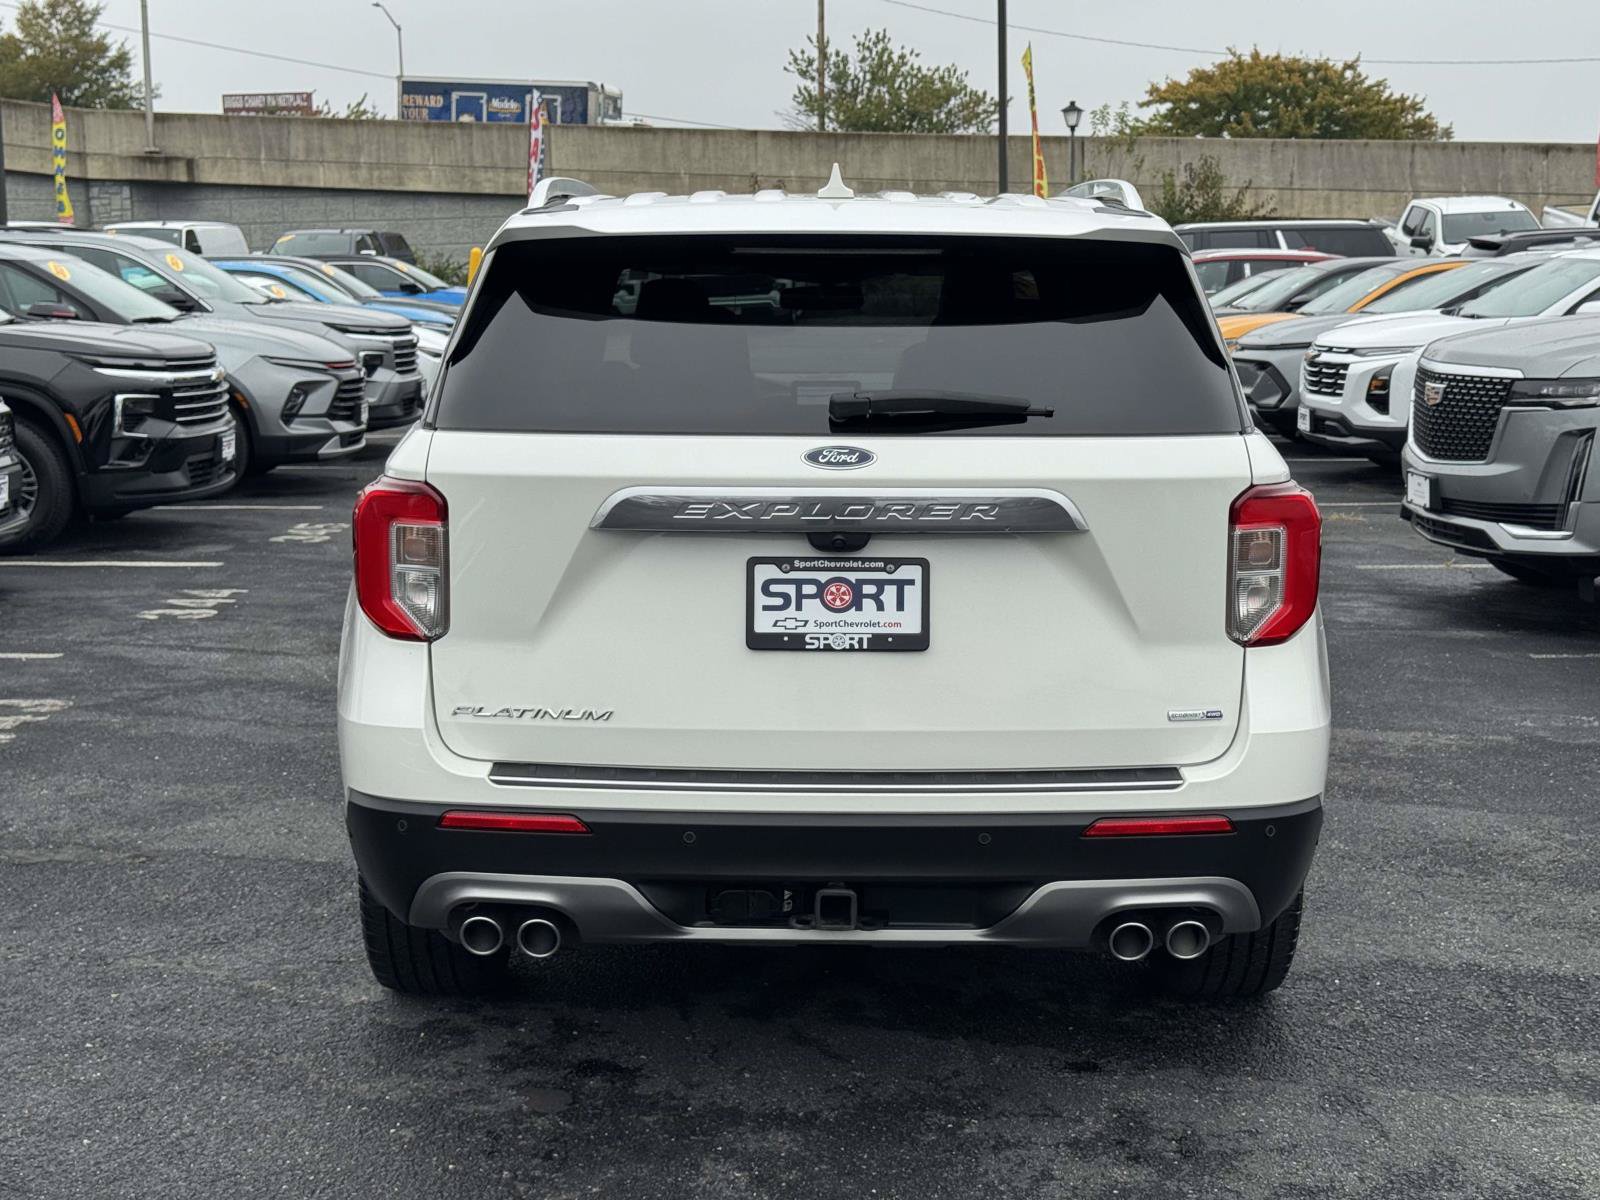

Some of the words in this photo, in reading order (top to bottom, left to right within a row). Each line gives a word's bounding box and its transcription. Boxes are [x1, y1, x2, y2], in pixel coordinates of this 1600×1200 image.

[402, 95, 443, 108] REWARD
[402, 108, 428, 120] YOUR
[818, 448, 860, 463] Ford
[673, 501, 1000, 521] EXPLORER
[793, 559, 885, 570] SportChevrolet.com
[760, 576, 916, 614] SPORT
[813, 619, 903, 630] SportChevrolet.com
[804, 632, 873, 650] SPORT
[451, 705, 615, 722] PLATINUM
